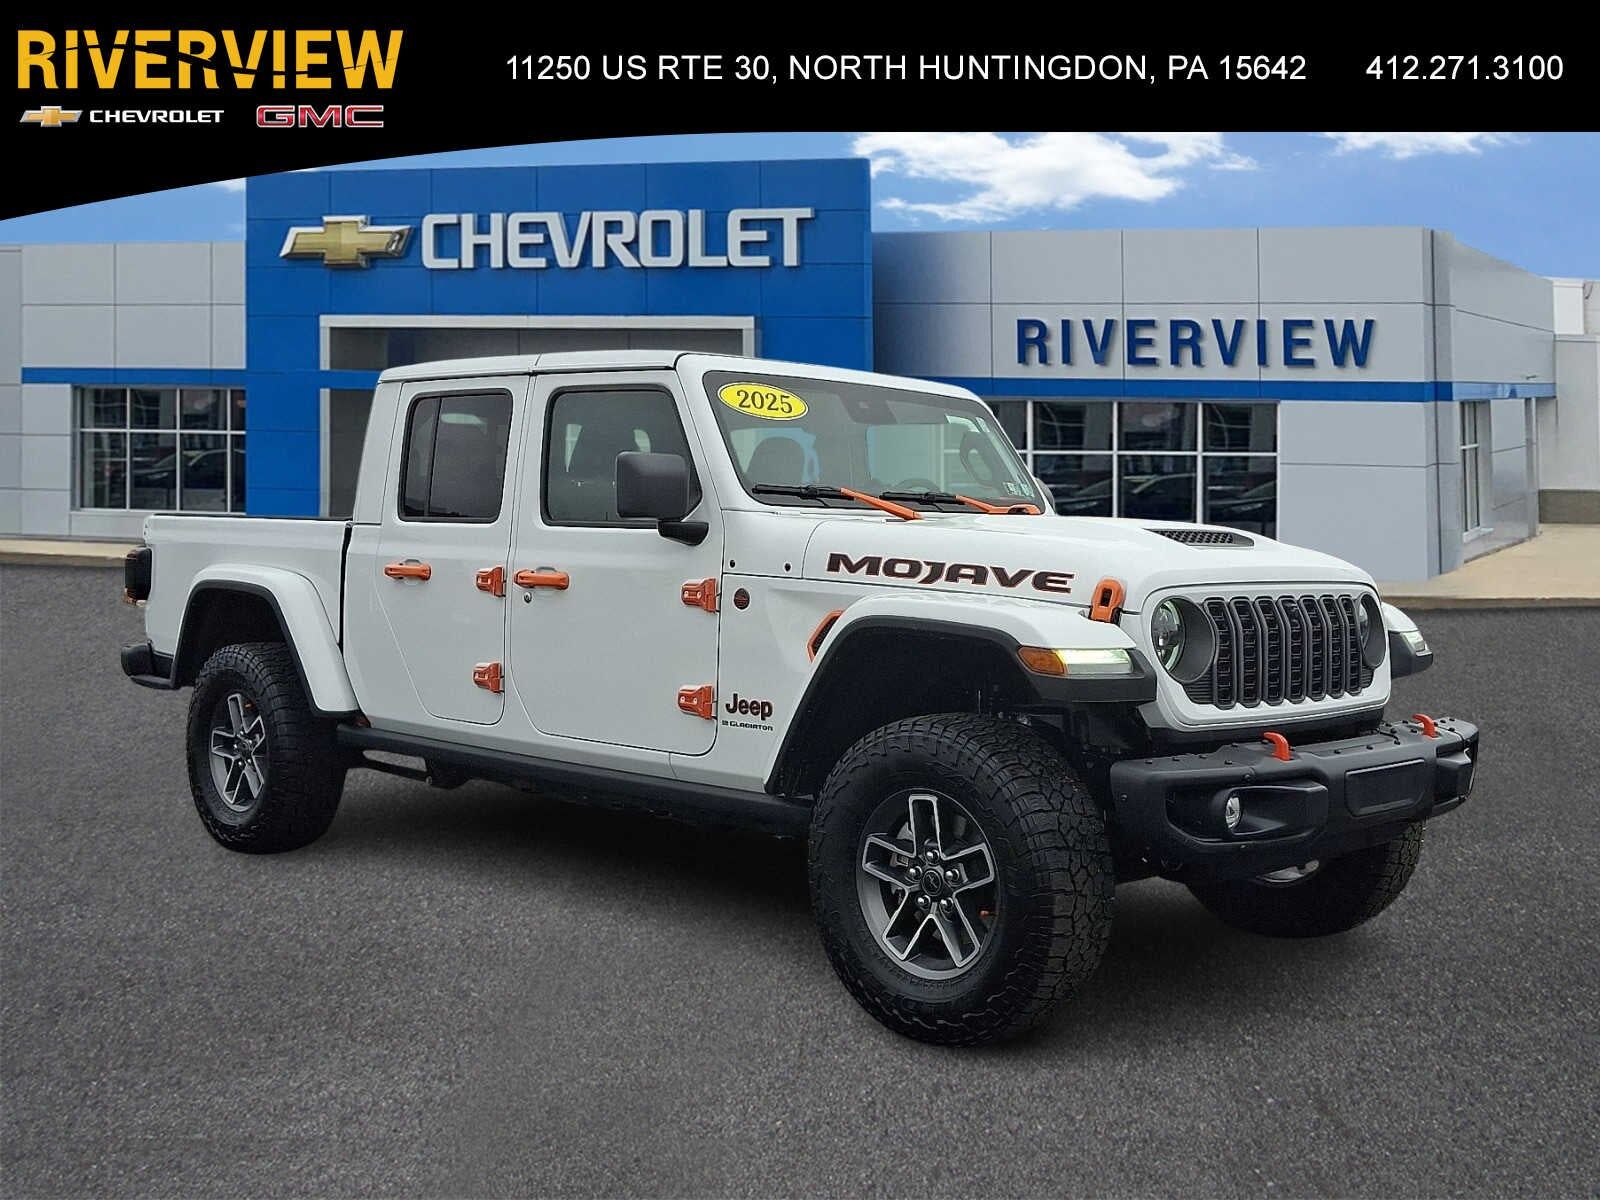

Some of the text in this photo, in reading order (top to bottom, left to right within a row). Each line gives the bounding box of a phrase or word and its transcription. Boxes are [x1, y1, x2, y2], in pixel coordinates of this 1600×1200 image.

[422, 207, 814, 269] CHEVROLET
[1016, 318, 1376, 369] RIVERVIEW
[736, 389, 793, 414] 2025
[826, 552, 1075, 594] MOJAVE
[725, 693, 773, 721] Jeep
